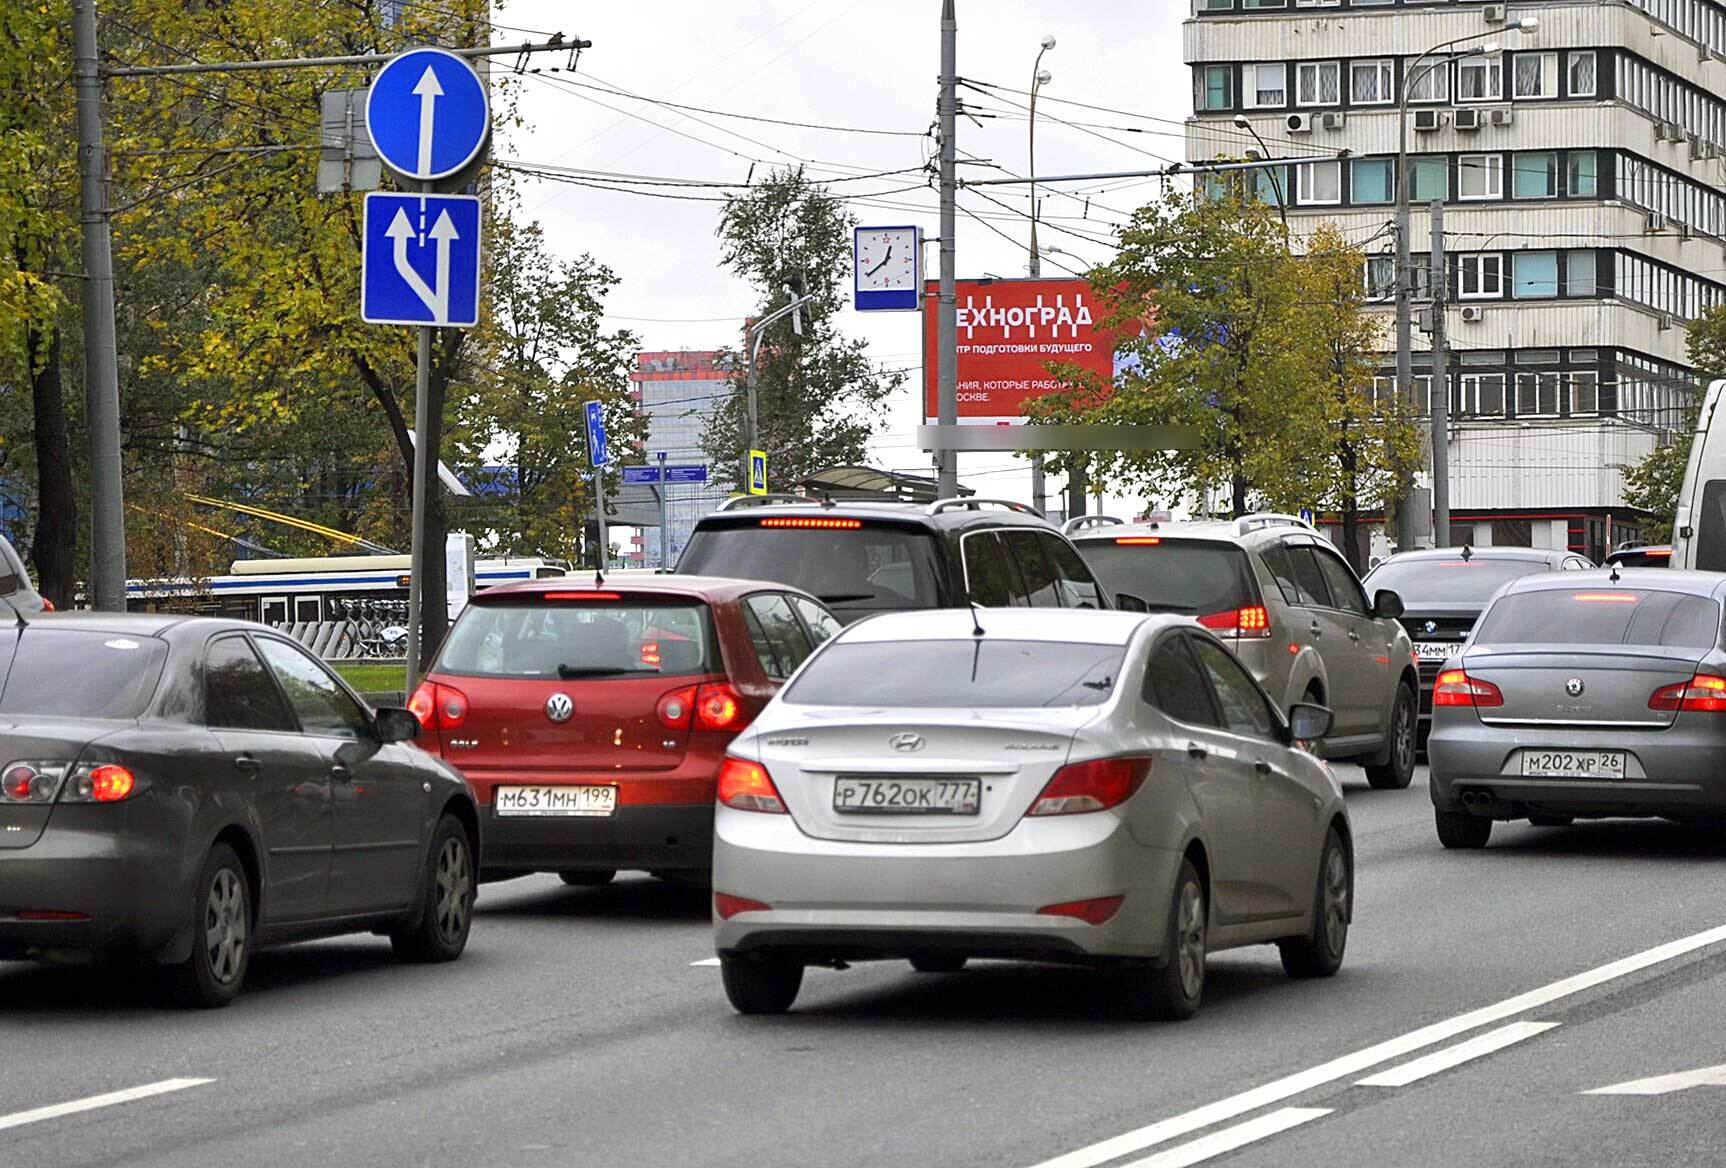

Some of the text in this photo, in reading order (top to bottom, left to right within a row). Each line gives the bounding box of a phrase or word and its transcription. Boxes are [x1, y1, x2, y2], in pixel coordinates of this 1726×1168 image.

[956, 294, 1093, 339] ЕХНОГРАД
[972, 344, 1038, 355] ПОДГОТОВКИ
[1039, 343, 1093, 354] БУДУЩЕГО
[956, 381, 982, 391] НИЯ,
[983, 380, 1030, 390] КОТОРЫЕ
[956, 392, 991, 402] ОСКВЕ.
[1414, 644, 1446, 657] 34ММ
